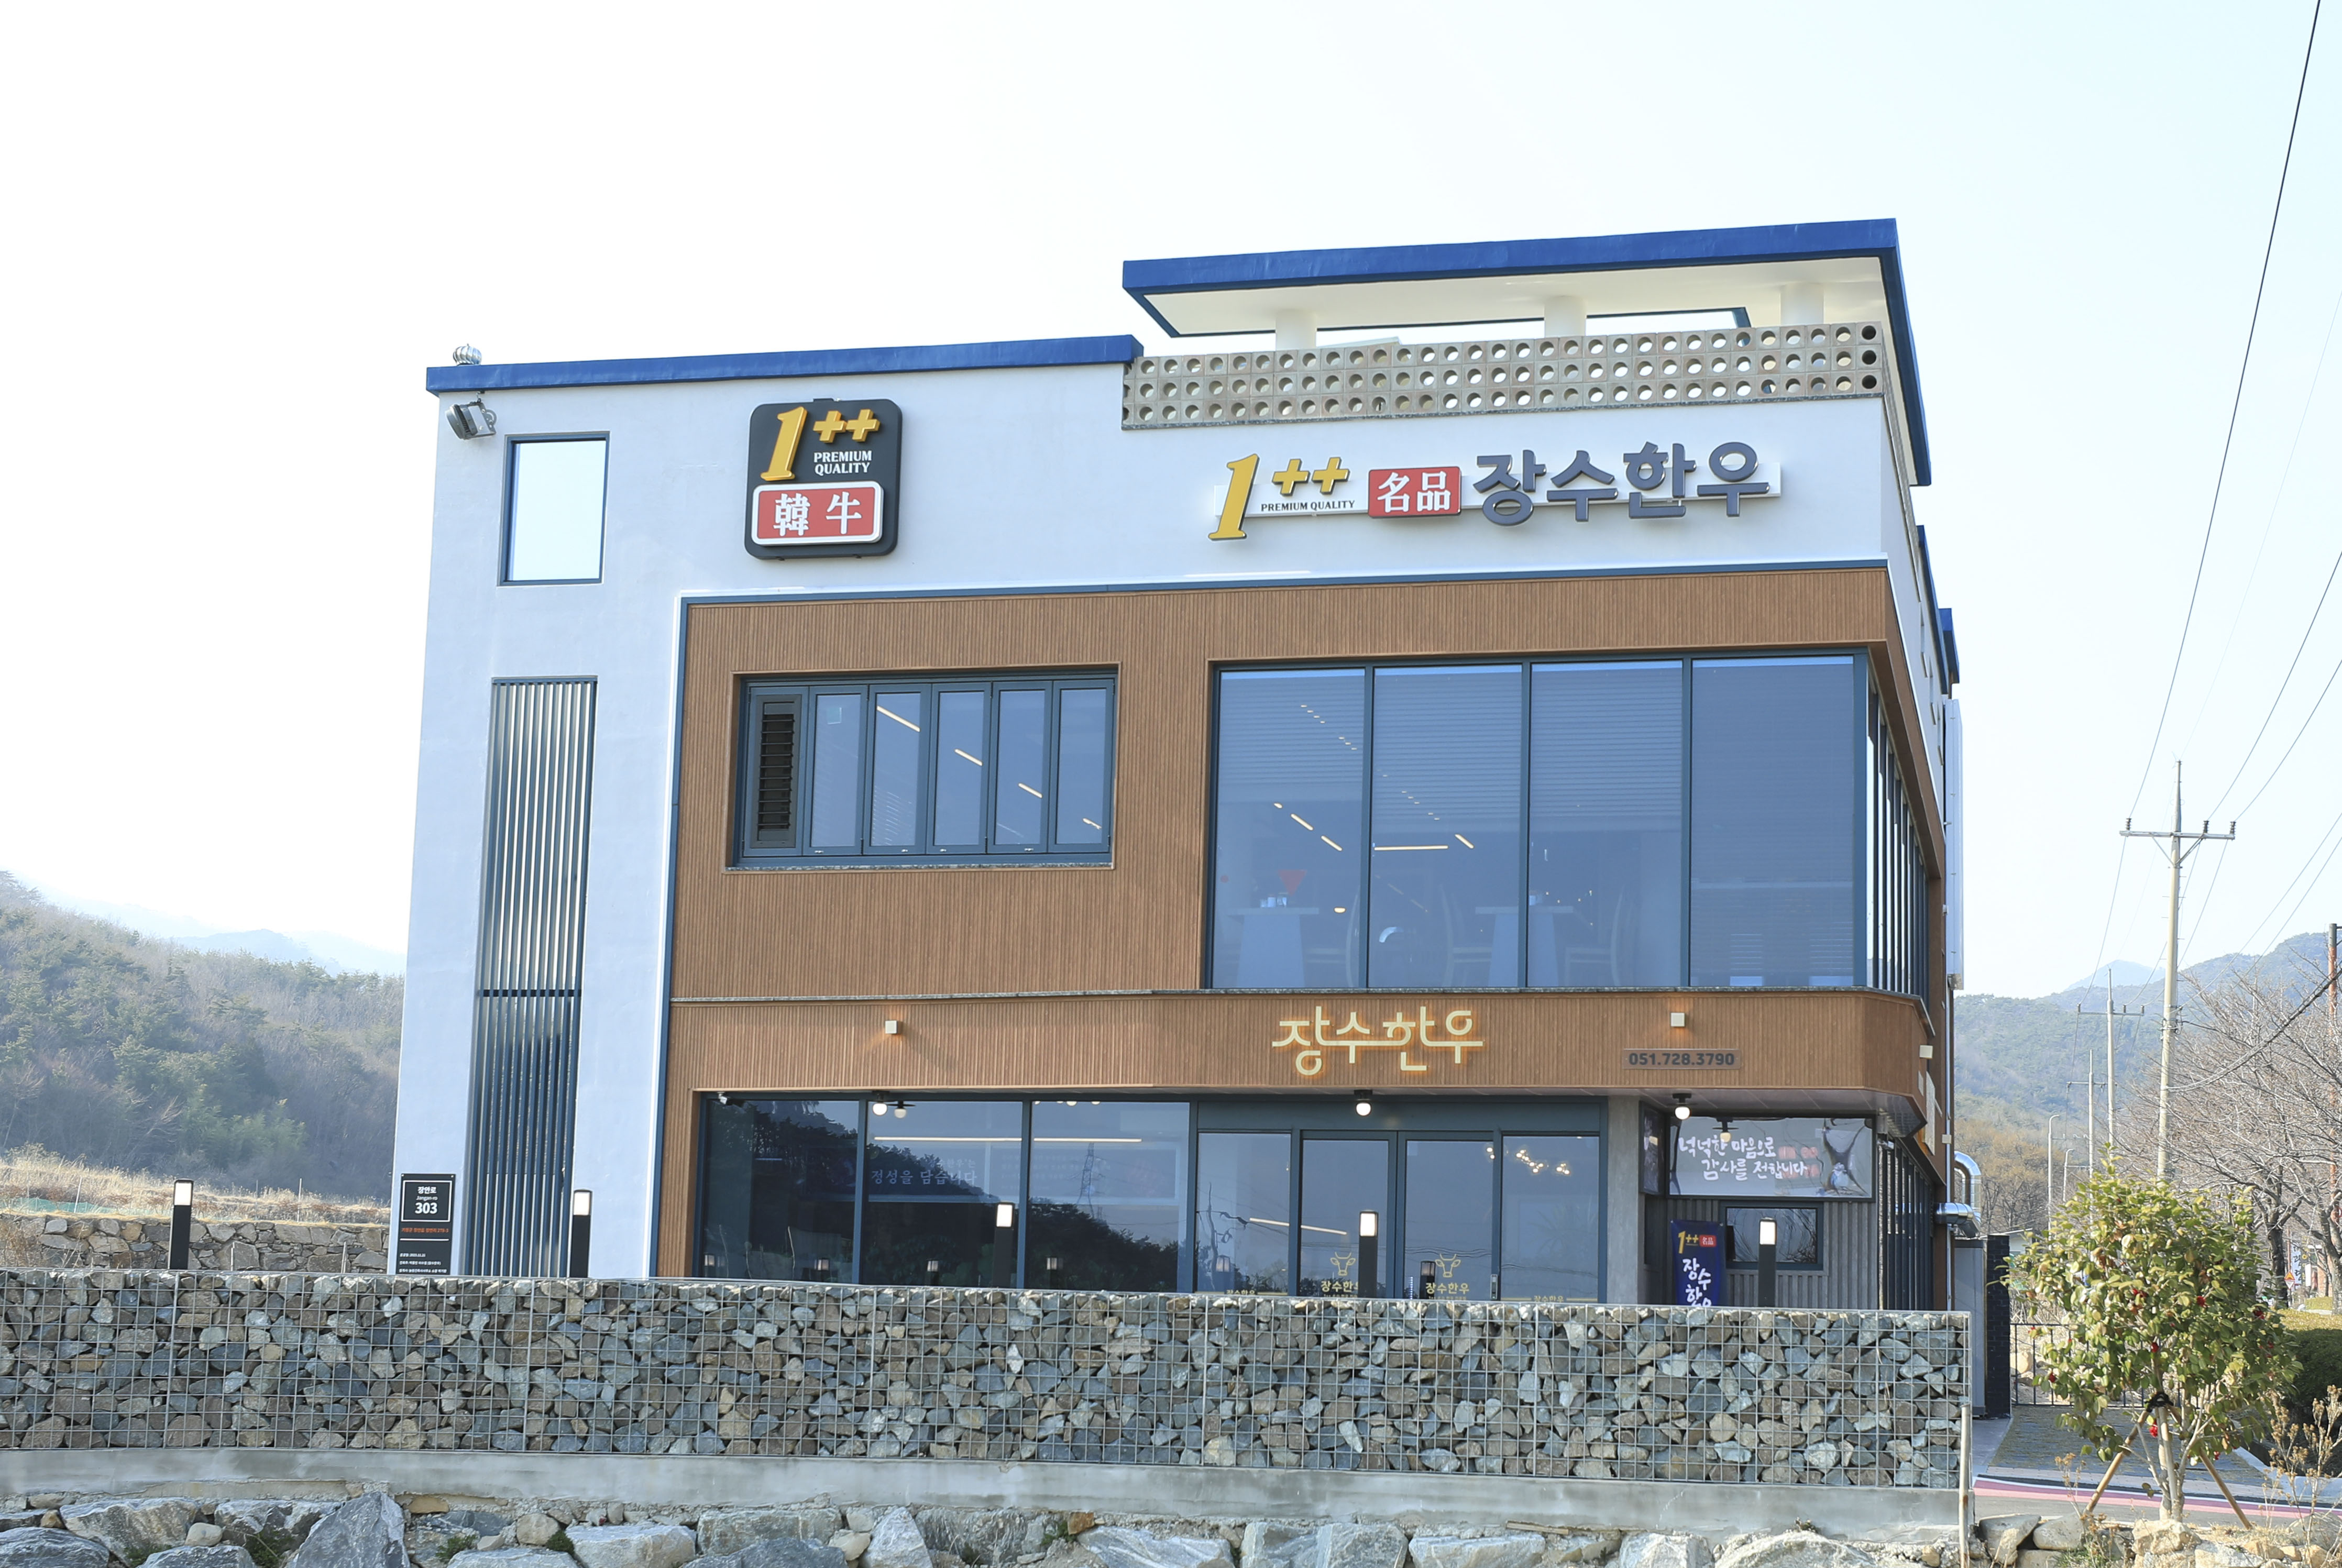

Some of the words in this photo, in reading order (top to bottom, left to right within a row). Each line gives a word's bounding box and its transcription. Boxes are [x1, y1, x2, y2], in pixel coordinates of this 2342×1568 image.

[813, 450, 872, 463] PREMIUM
[815, 462, 870, 477] QUALITY
[1378, 471, 1452, 513] 名品
[1473, 441, 1770, 526] 장수한우
[1261, 502, 1308, 512] PREMIUM
[1310, 500, 1355, 511] QUALITY
[1272, 1006, 1483, 1076] 장수한우
[1629, 1053, 1735, 1066] 051.728.3790
[1678, 1135, 1728, 1157] 넉넉한
[1731, 1136, 1777, 1159] 마음으로
[1701, 1158, 1749, 1181] 감사를
[1753, 1161, 1808, 1179] 전합니다
[872, 1169, 914, 1185] 정성을
[920, 1169, 977, 1186] 담습니다
[415, 1202, 438, 1214] 303
[1425, 1282, 1469, 1295] 장수한우
